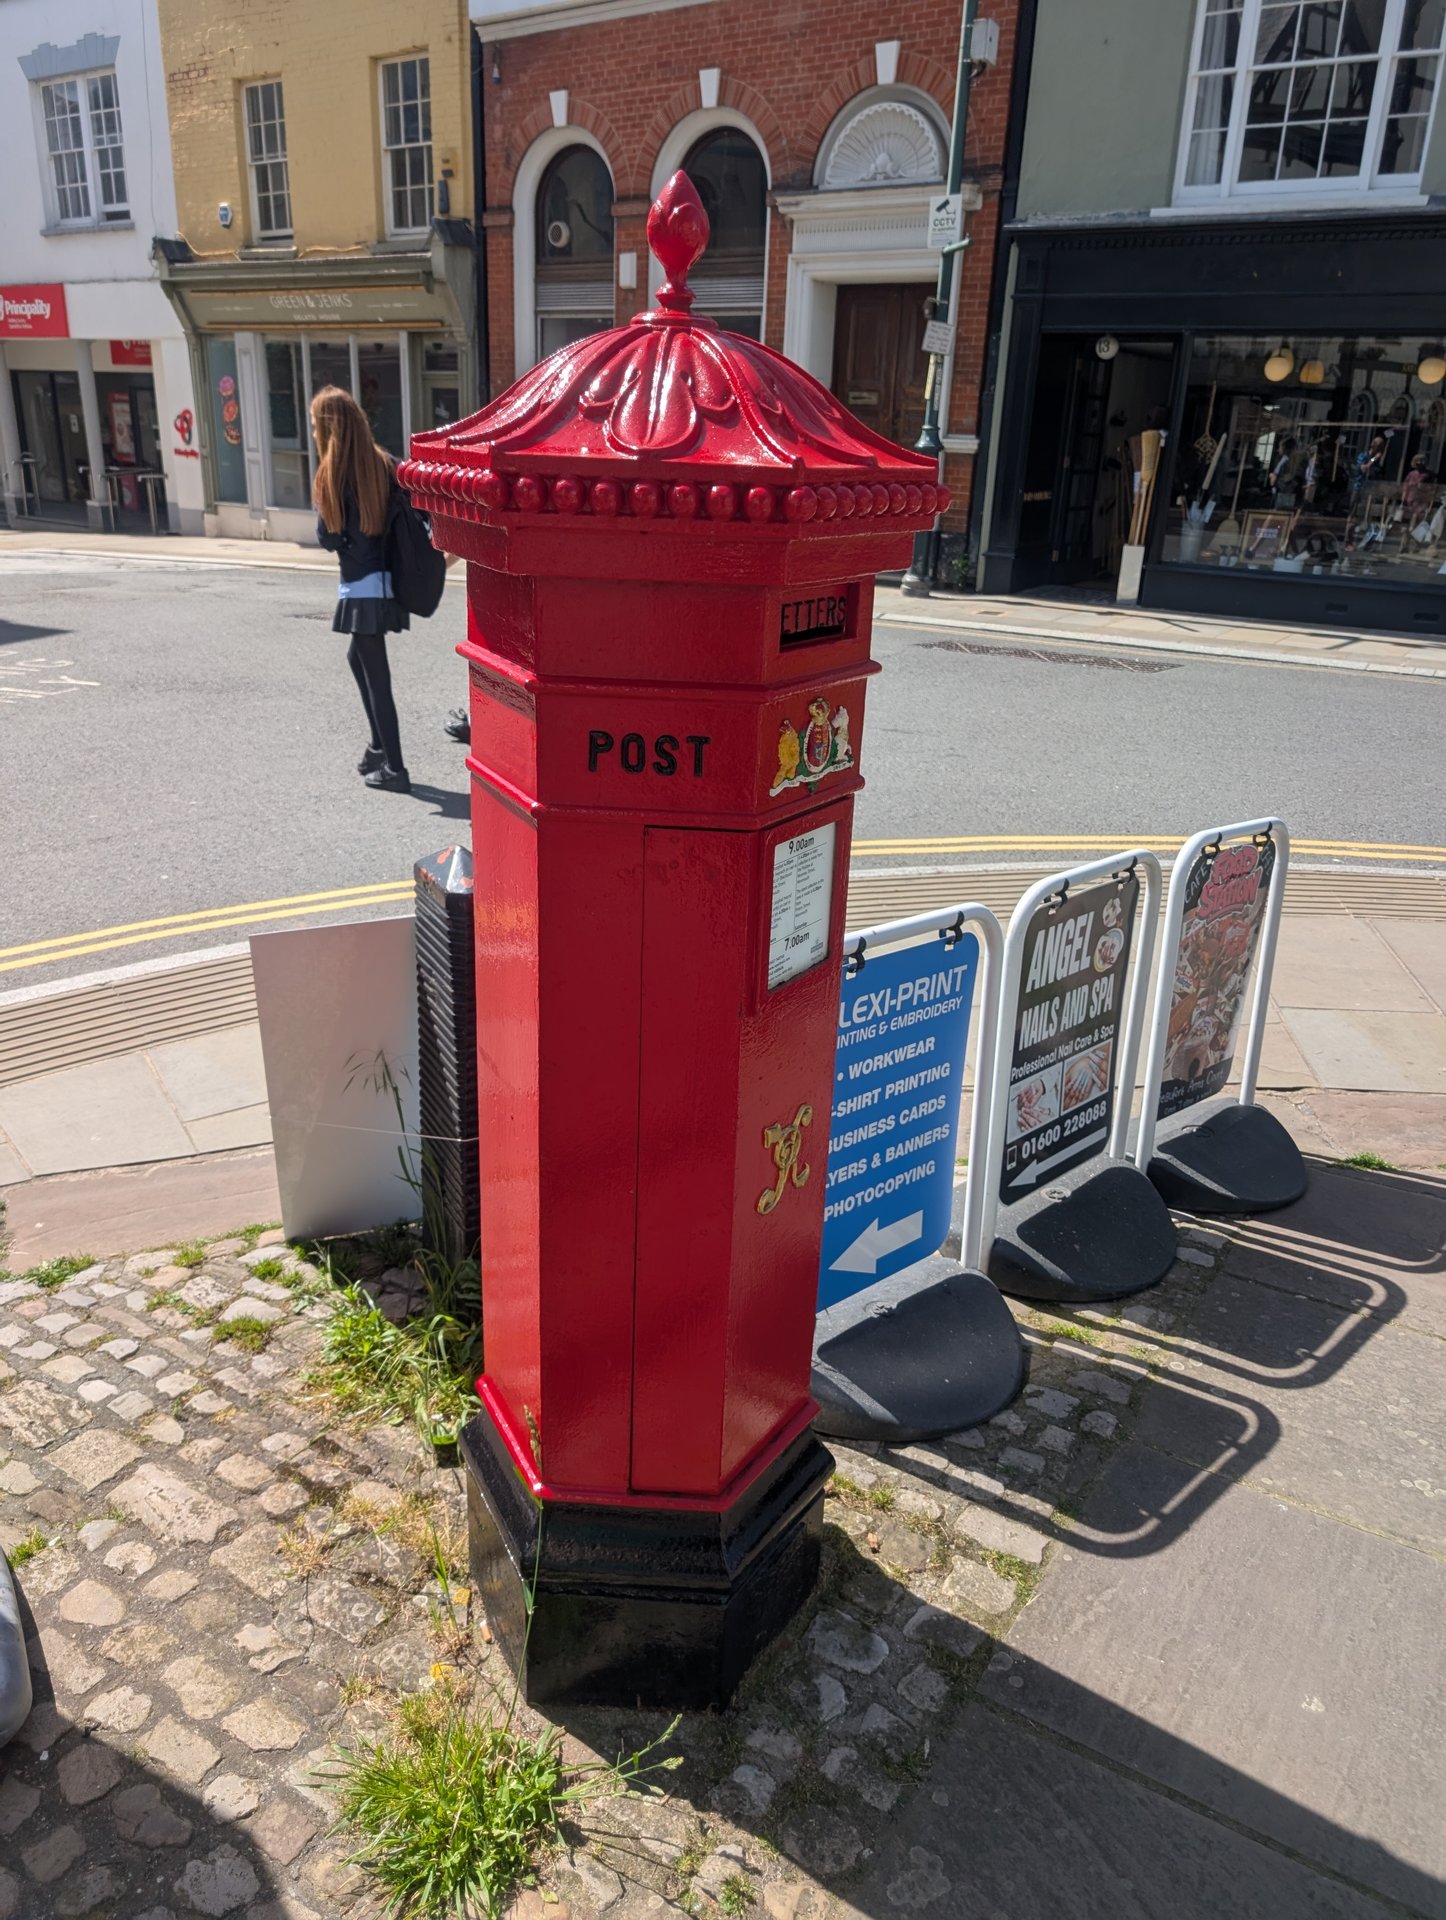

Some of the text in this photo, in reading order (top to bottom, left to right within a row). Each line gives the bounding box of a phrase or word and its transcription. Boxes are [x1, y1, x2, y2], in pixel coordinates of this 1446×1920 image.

[933, 217, 956, 227] CCTV
[4, 298, 51, 319] Principality
[269, 295, 305, 309] GREEN
[315, 293, 353, 308] JENKS
[781, 596, 847, 634] ETTERS
[588, 730, 712, 778] POST
[788, 837, 815, 855] 9.00am
[1185, 862, 1209, 904] CAFE
[784, 932, 810, 951] 7.00am
[1025, 911, 1095, 993] ANGEL
[838, 964, 968, 1028] LEXI-PRINT
[1018, 973, 1115, 1051] NAILS AND SPA
[836, 995, 963, 1050] INTING & EMBROIDERY
[848, 1036, 936, 1080] WORKWEAR
[1010, 1023, 1115, 1082] Professional Nail Care & Spa
[831, 1062, 951, 1118] -SHIRT PRINTING
[899, 1094, 947, 1125] CARDS
[1021, 1100, 1107, 1159] 01600 228088
[825, 1124, 950, 1189] YERS & BANNERS
[823, 1160, 936, 1222] PHOTOCOPYING
